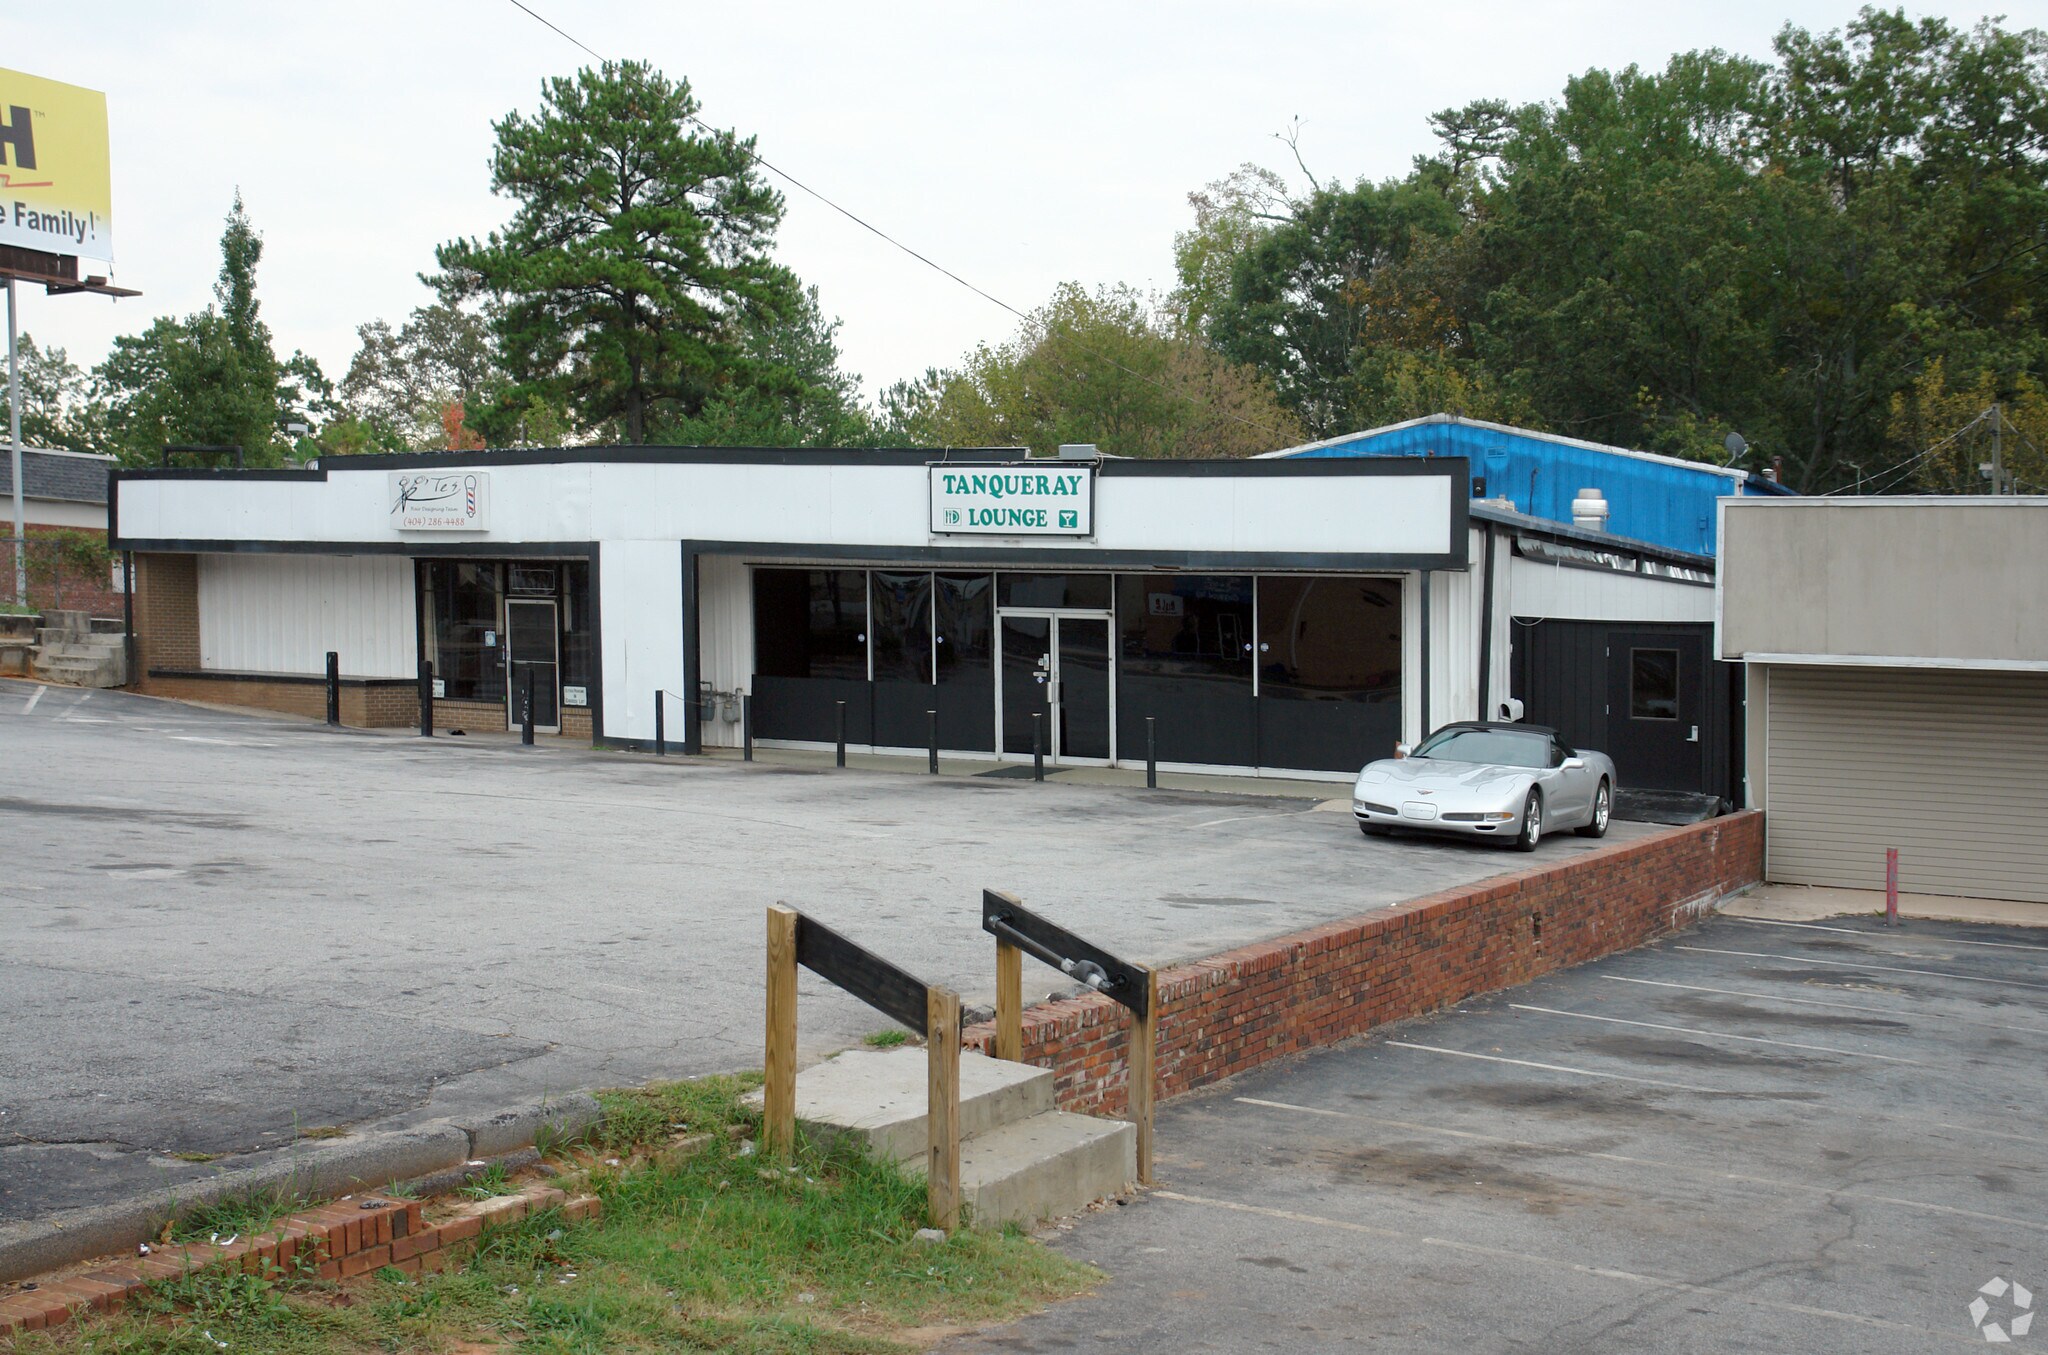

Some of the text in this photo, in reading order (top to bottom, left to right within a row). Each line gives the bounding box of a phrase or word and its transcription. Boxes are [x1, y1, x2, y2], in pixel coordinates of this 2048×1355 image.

[14, 200, 95, 244] Family!
[942, 474, 1083, 499] TANQUERAY
[403, 517, 426, 527] (404)
[968, 508, 1048, 527] LOUNGE
